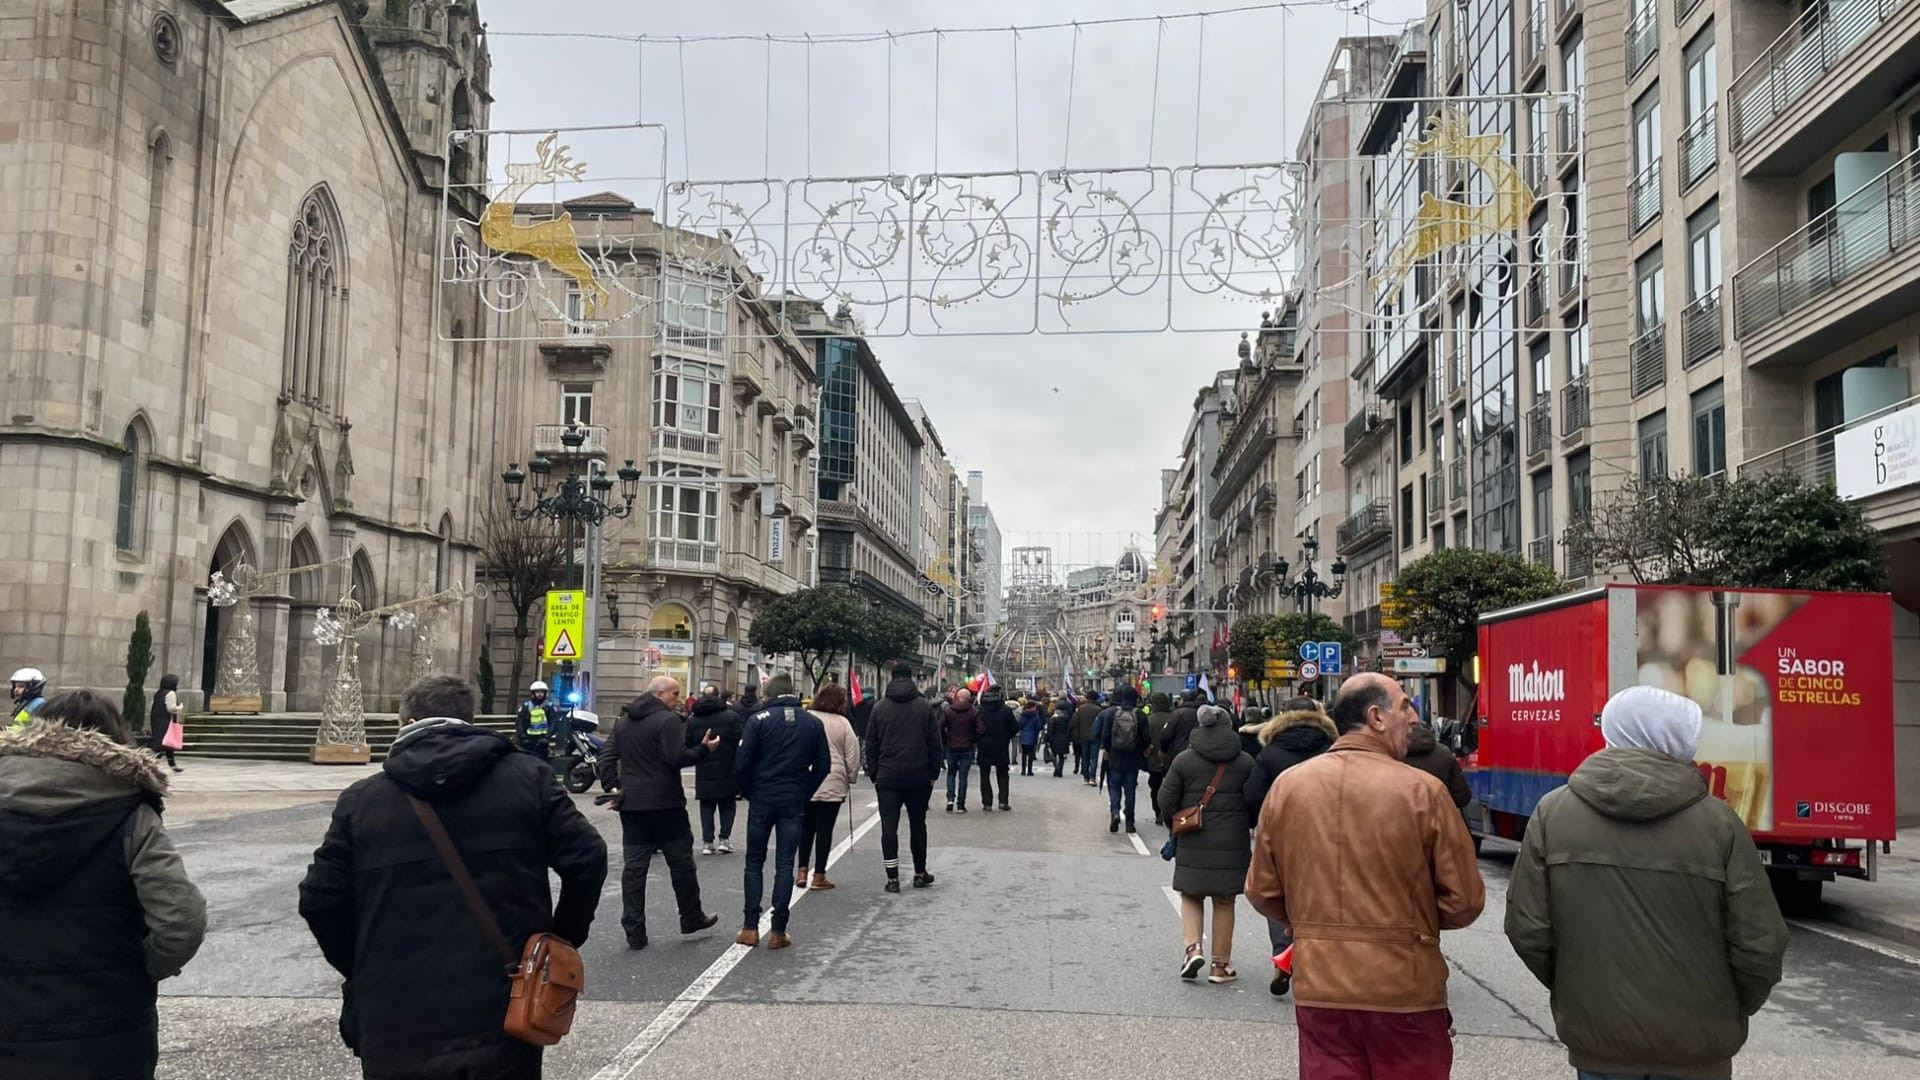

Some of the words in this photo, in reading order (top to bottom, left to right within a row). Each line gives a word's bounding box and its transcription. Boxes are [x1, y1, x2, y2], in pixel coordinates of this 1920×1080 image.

[772, 521, 780, 558] mazars
[1325, 647, 1335, 659] P
[1778, 647, 1796, 658] UN
[1303, 666, 1316, 674] 30
[1778, 658, 1845, 676] SABOR
[1508, 659, 1565, 702] Mahou
[1779, 677, 1795, 688] DE
[1798, 677, 1844, 690] CINCO
[1779, 690, 1861, 705] ESTRELLAS
[1511, 709, 1561, 721] CERVEZAS
[1814, 801, 1871, 814] DISGOBE
